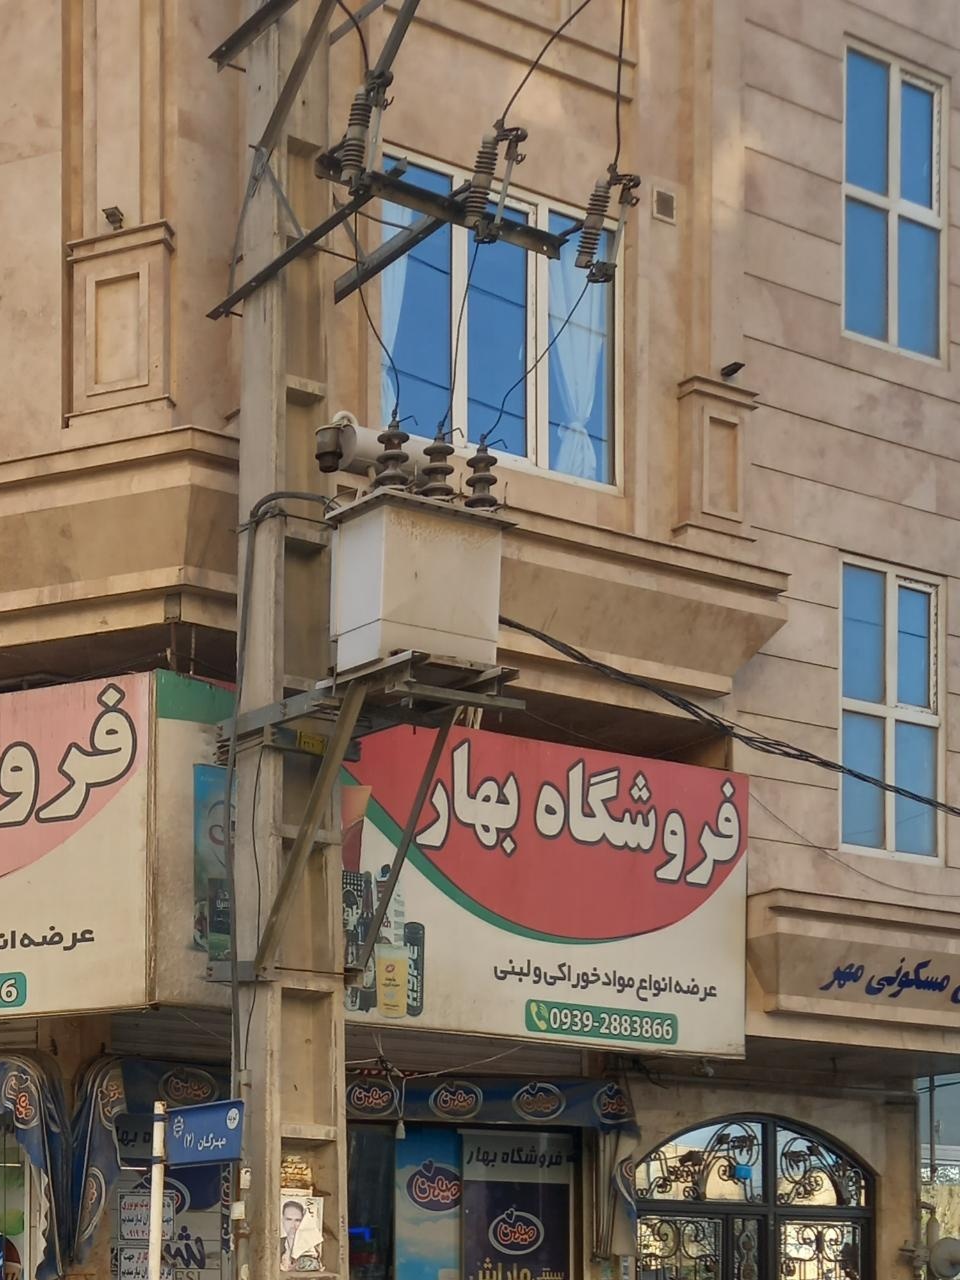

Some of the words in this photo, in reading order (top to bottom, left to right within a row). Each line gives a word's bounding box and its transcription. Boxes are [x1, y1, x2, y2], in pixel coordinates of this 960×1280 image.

[414, 737, 520, 857] بهار
[534, 757, 740, 887] فروشگاه
[20, 925, 95, 951] عرضه
[493, 959, 531, 982] لبنی
[533, 966, 542, 984] و
[543, 962, 601, 989] خوراکی
[602, 970, 635, 993] مواد
[818, 963, 865, 991] مهر
[865, 957, 951, 998] مسکونی
[637, 975, 672, 1001] انواع
[674, 978, 718, 1001] عرضه
[550, 1007, 673, 1040] 0939-2883866
[197, 1132, 227, 1151] مهرگان
[466, 1146, 498, 1167] بهار
[501, 1145, 563, 1168] فروشگاه
